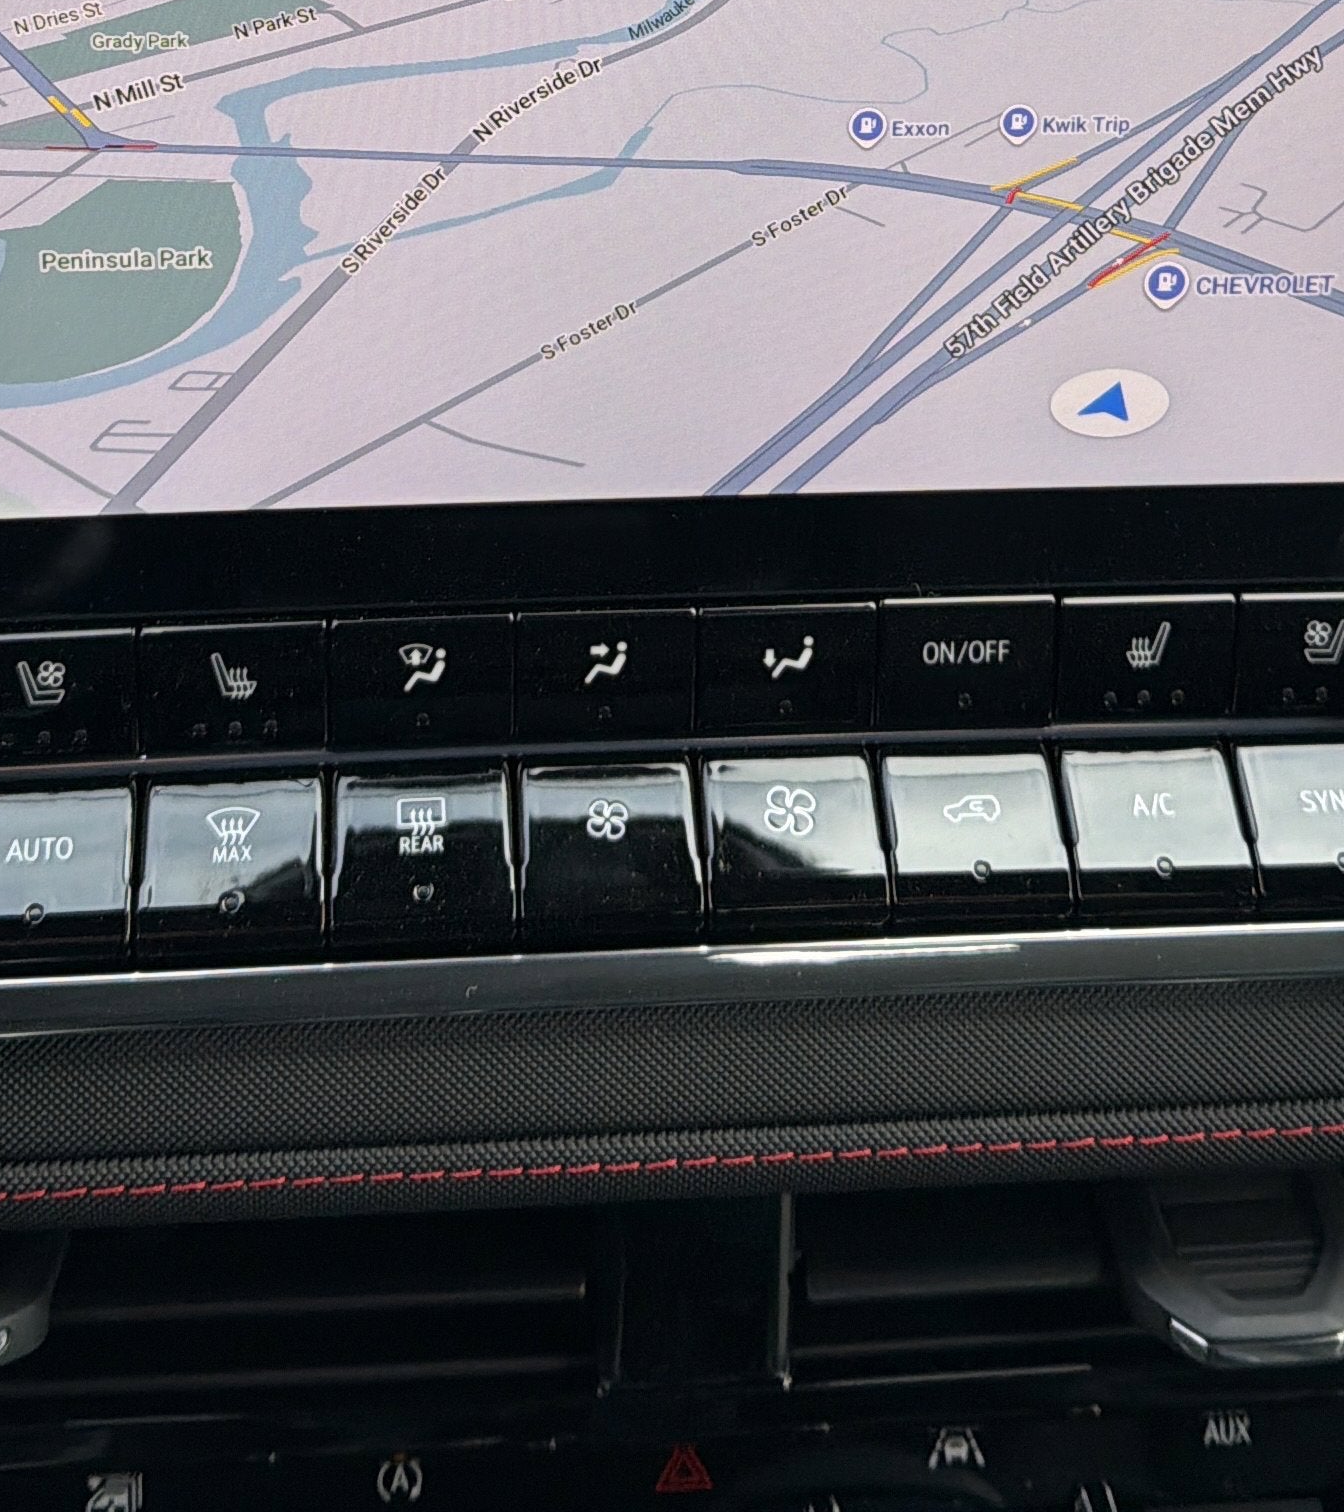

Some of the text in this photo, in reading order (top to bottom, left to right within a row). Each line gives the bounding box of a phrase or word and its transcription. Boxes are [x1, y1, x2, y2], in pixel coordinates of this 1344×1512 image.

[14, 1, 103, 35] N Dries St
[234, 8, 317, 40] N Park St
[92, 33, 188, 52] Grady Park
[93, 73, 184, 111] N Mill St
[472, 57, 604, 143] N Riverside Dr
[892, 119, 950, 138] Exxon
[1042, 115, 1130, 138] Kwik Trip
[751, 185, 848, 247] S Foster Dr
[943, 45, 1325, 360] 57th Field Artillery Brigade Mem Hwy
[341, 167, 447, 275] S Riverside Dr
[42, 248, 211, 271] Peninsula Park
[1197, 275, 1335, 296] CHEVROLET
[541, 300, 638, 361] S Foster Dr
[923, 639, 1011, 665] ON/OFF
[1132, 792, 1176, 819] A/C
[5, 835, 74, 864] AUTO
[212, 845, 252, 863] MAX
[399, 834, 444, 856] REAR
[1203, 1410, 1252, 1447] AUX
